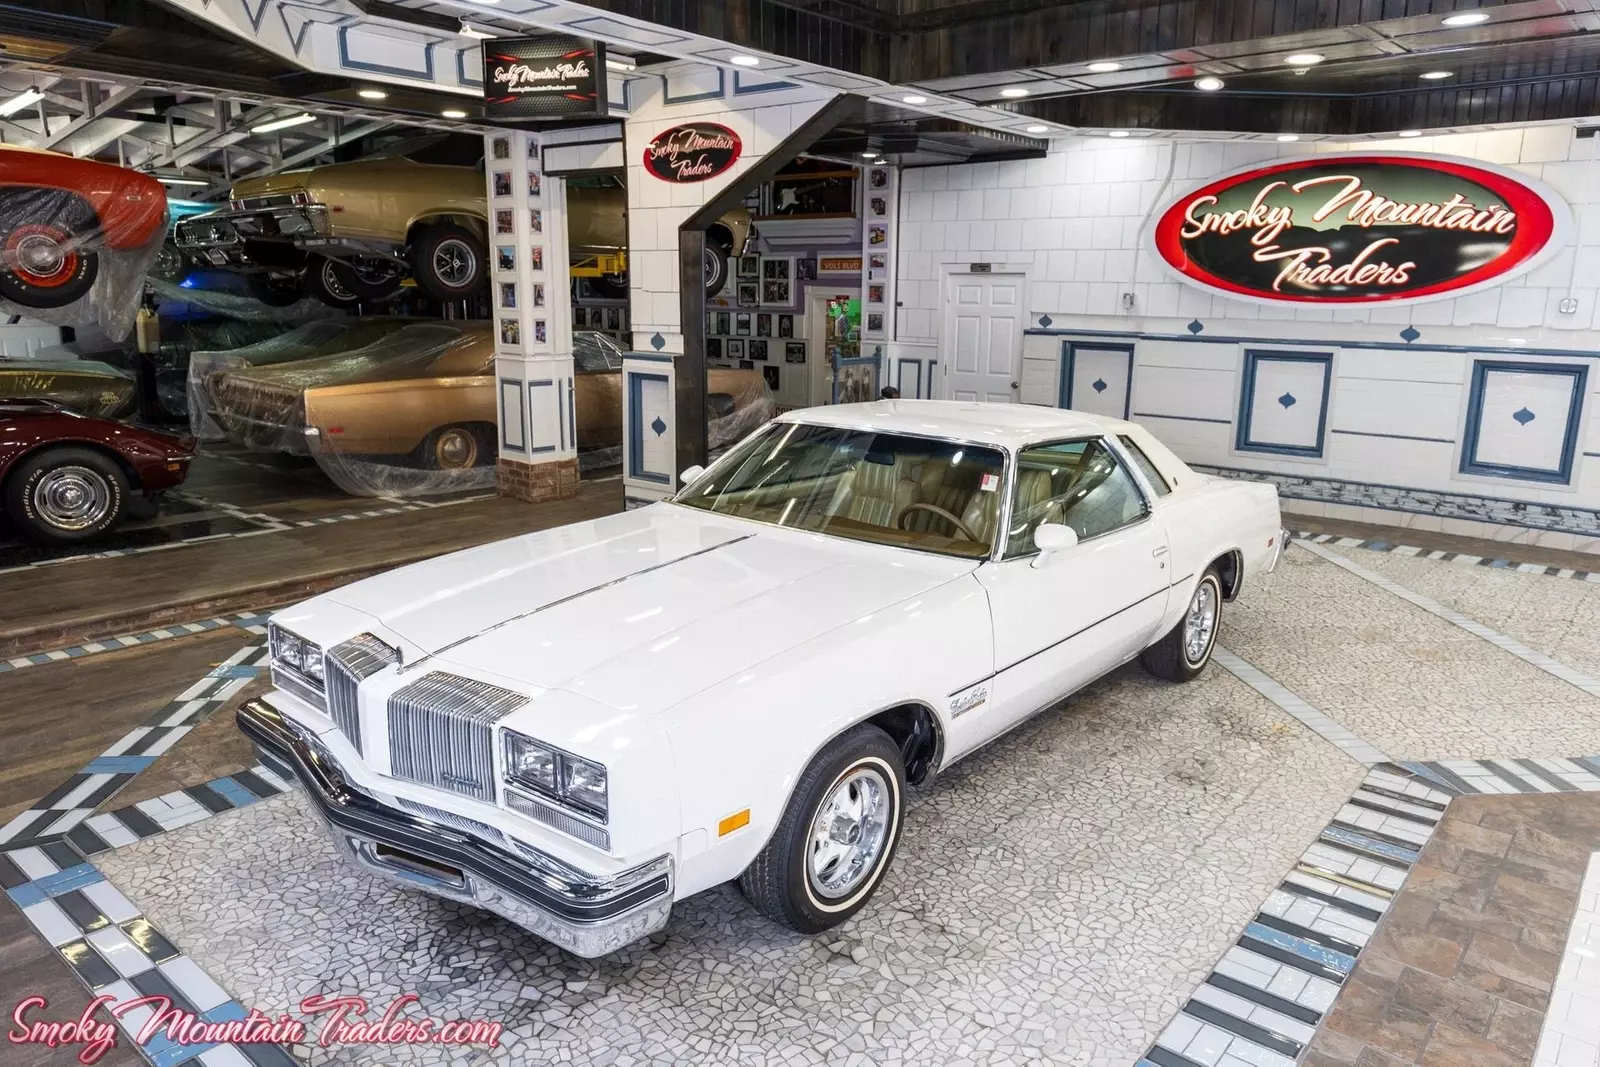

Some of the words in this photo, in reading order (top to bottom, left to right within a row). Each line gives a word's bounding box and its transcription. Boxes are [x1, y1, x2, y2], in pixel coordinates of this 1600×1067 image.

[649, 133, 680, 161] Smoky
[678, 128, 734, 150] Mountain
[670, 153, 713, 180] Traders
[1181, 181, 1292, 243] Smoky
[1292, 175, 1516, 235] Mountain
[1253, 238, 1417, 291] Traders
[23, 484, 35, 519] Radial
[29, 469, 43, 482] T/A
[98, 474, 121, 530] BFGoodrich
